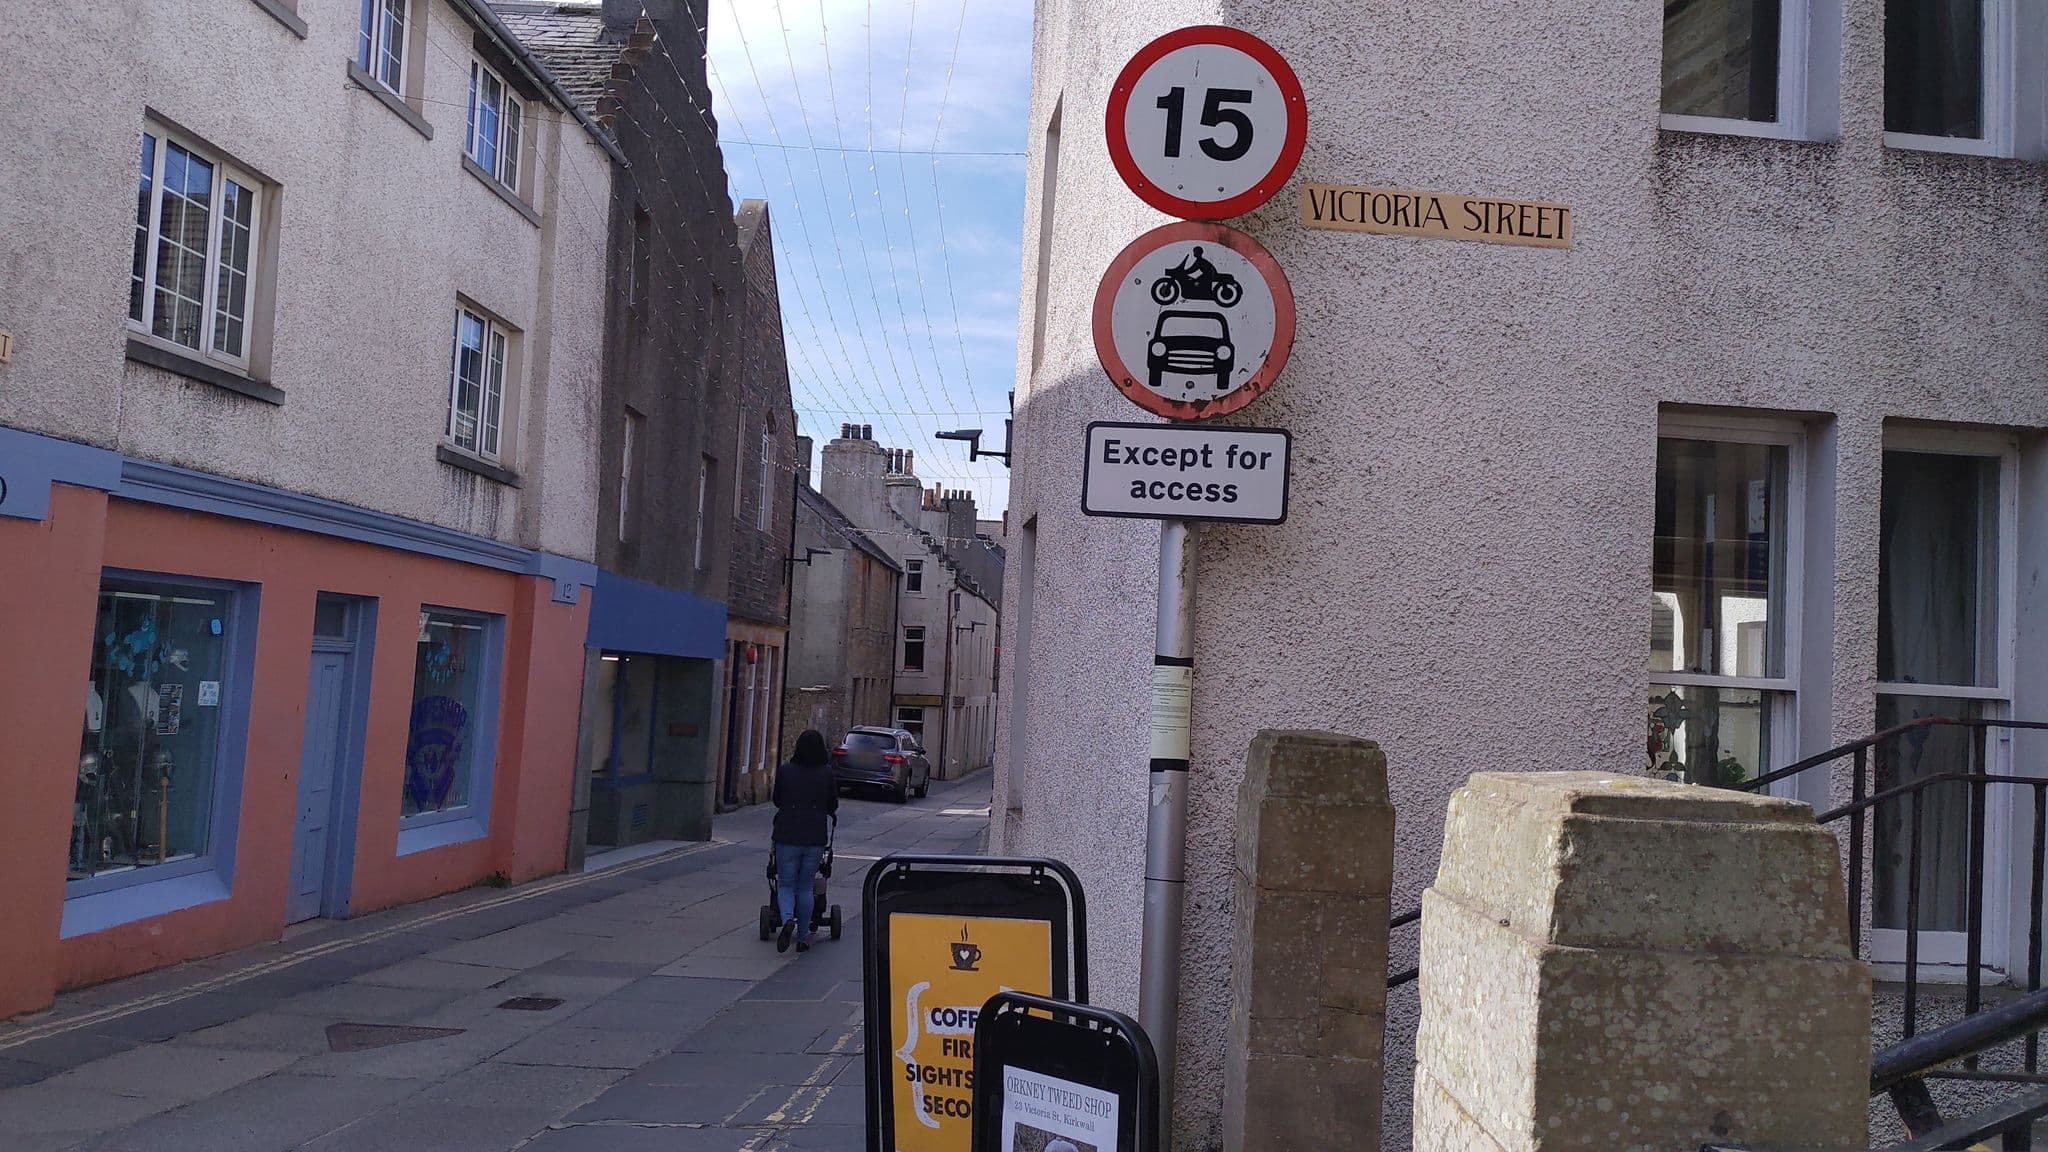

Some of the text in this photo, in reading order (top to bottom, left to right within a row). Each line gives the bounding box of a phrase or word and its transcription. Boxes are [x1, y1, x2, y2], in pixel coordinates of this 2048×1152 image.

[1155, 86, 1254, 162] 15
[1308, 188, 1570, 240] VICTORIA STREET
[1103, 438, 1273, 472] Except for
[1130, 479, 1239, 503] access
[562, 583, 573, 600] 12
[942, 1037, 975, 1059] FIR
[905, 1062, 975, 1090] SIGHTS
[1006, 1075, 1112, 1119] ORKNEY TWEED SHOP
[1014, 1100, 1095, 1132] 23 Victoria St, Kirkwall
